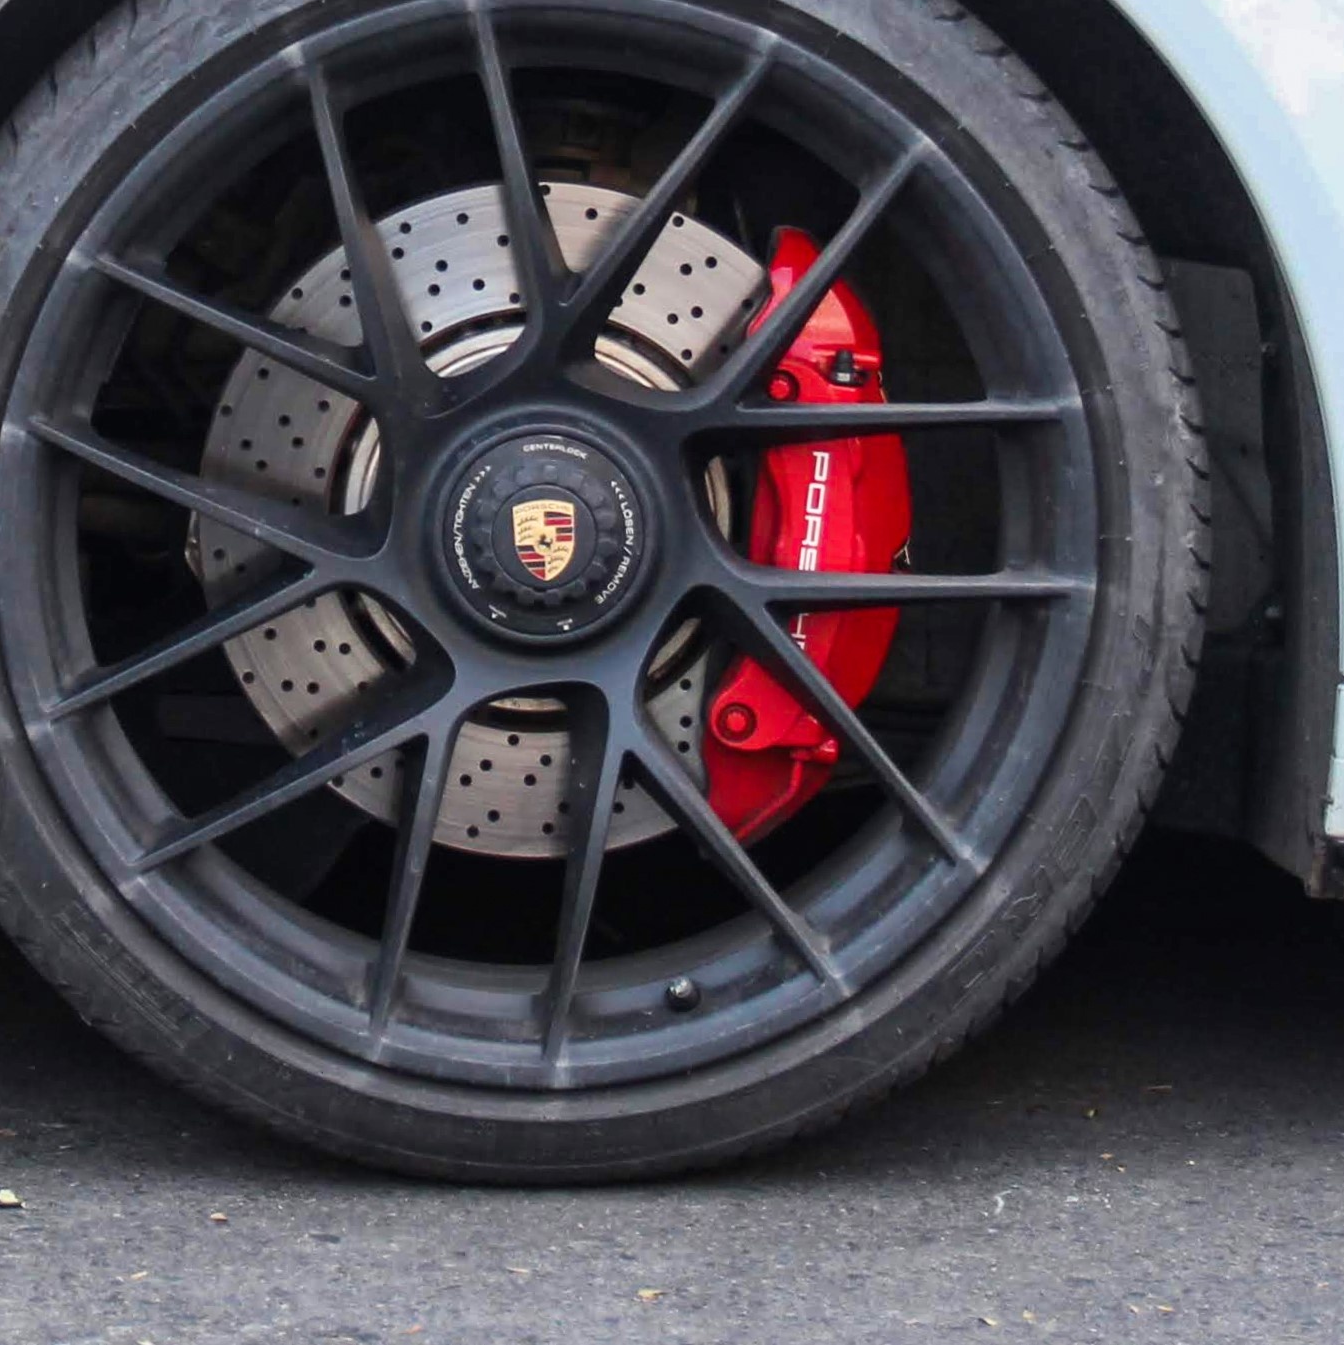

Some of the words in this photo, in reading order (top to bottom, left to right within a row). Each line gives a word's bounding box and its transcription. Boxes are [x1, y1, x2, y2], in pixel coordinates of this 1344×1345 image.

[523, 443, 588, 459] CENTERLOCK
[790, 451, 830, 651] PORSH
[595, 555, 631, 605] REMOVE
